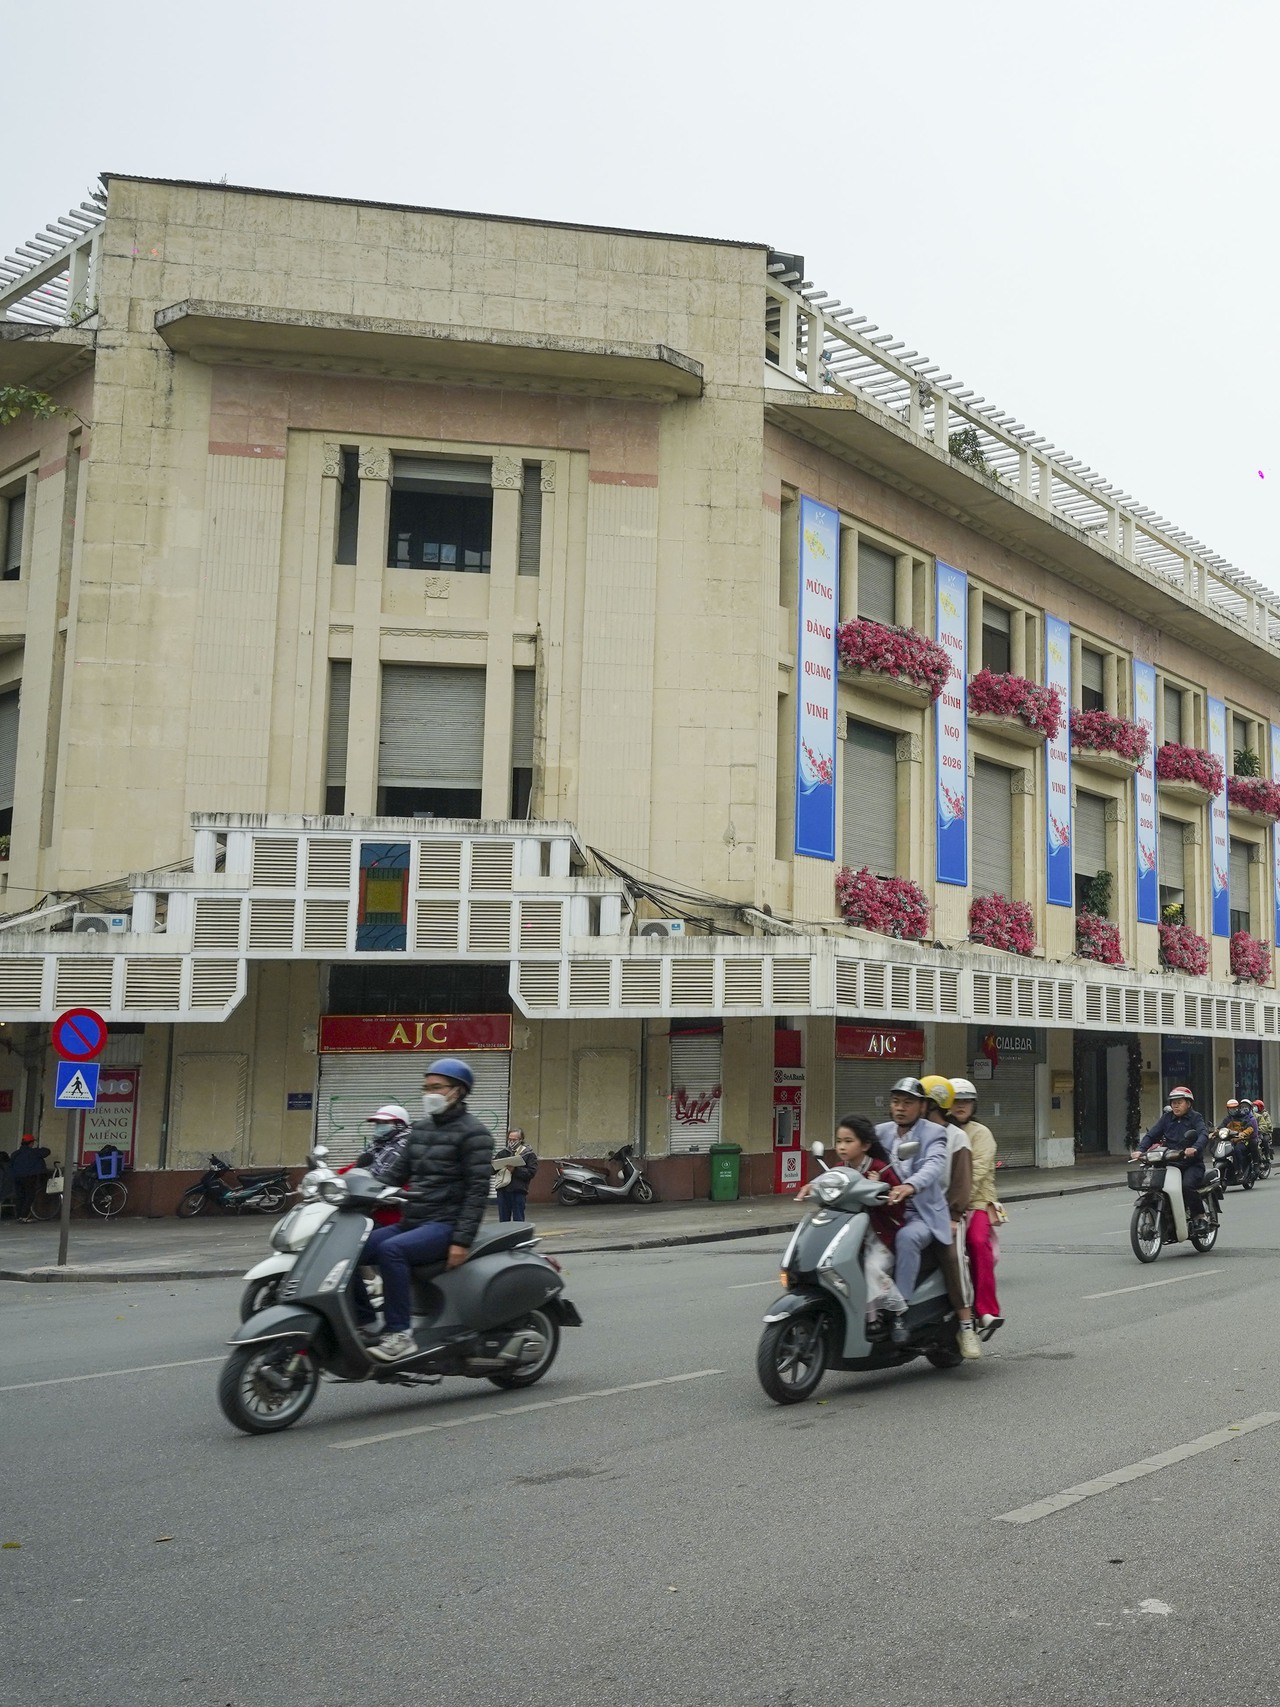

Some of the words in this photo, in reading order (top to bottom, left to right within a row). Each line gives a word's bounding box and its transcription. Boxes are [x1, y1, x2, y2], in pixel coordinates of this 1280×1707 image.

[806, 579, 833, 600] MỪNG
[806, 619, 831, 639] ĐẢNG
[941, 632, 963, 650] MỪNG
[805, 661, 831, 680] QUANG
[943, 692, 961, 709] BÍNH
[806, 702, 829, 720] VINH
[944, 724, 960, 741] NGỌ
[943, 755, 962, 770] 2026
[1050, 748, 1067, 762] QUANG
[1051, 781, 1066, 795] VINH
[1140, 818, 1153, 830] 2026
[388, 1022, 448, 1048] AJC
[986, 1036, 1032, 1050] CIALBAR
[868, 1034, 897, 1056] AJC
[783, 1073, 805, 1081] SeABank
[90, 1116, 128, 1128] VÀNG
[88, 1128, 128, 1140] MIẾNG
